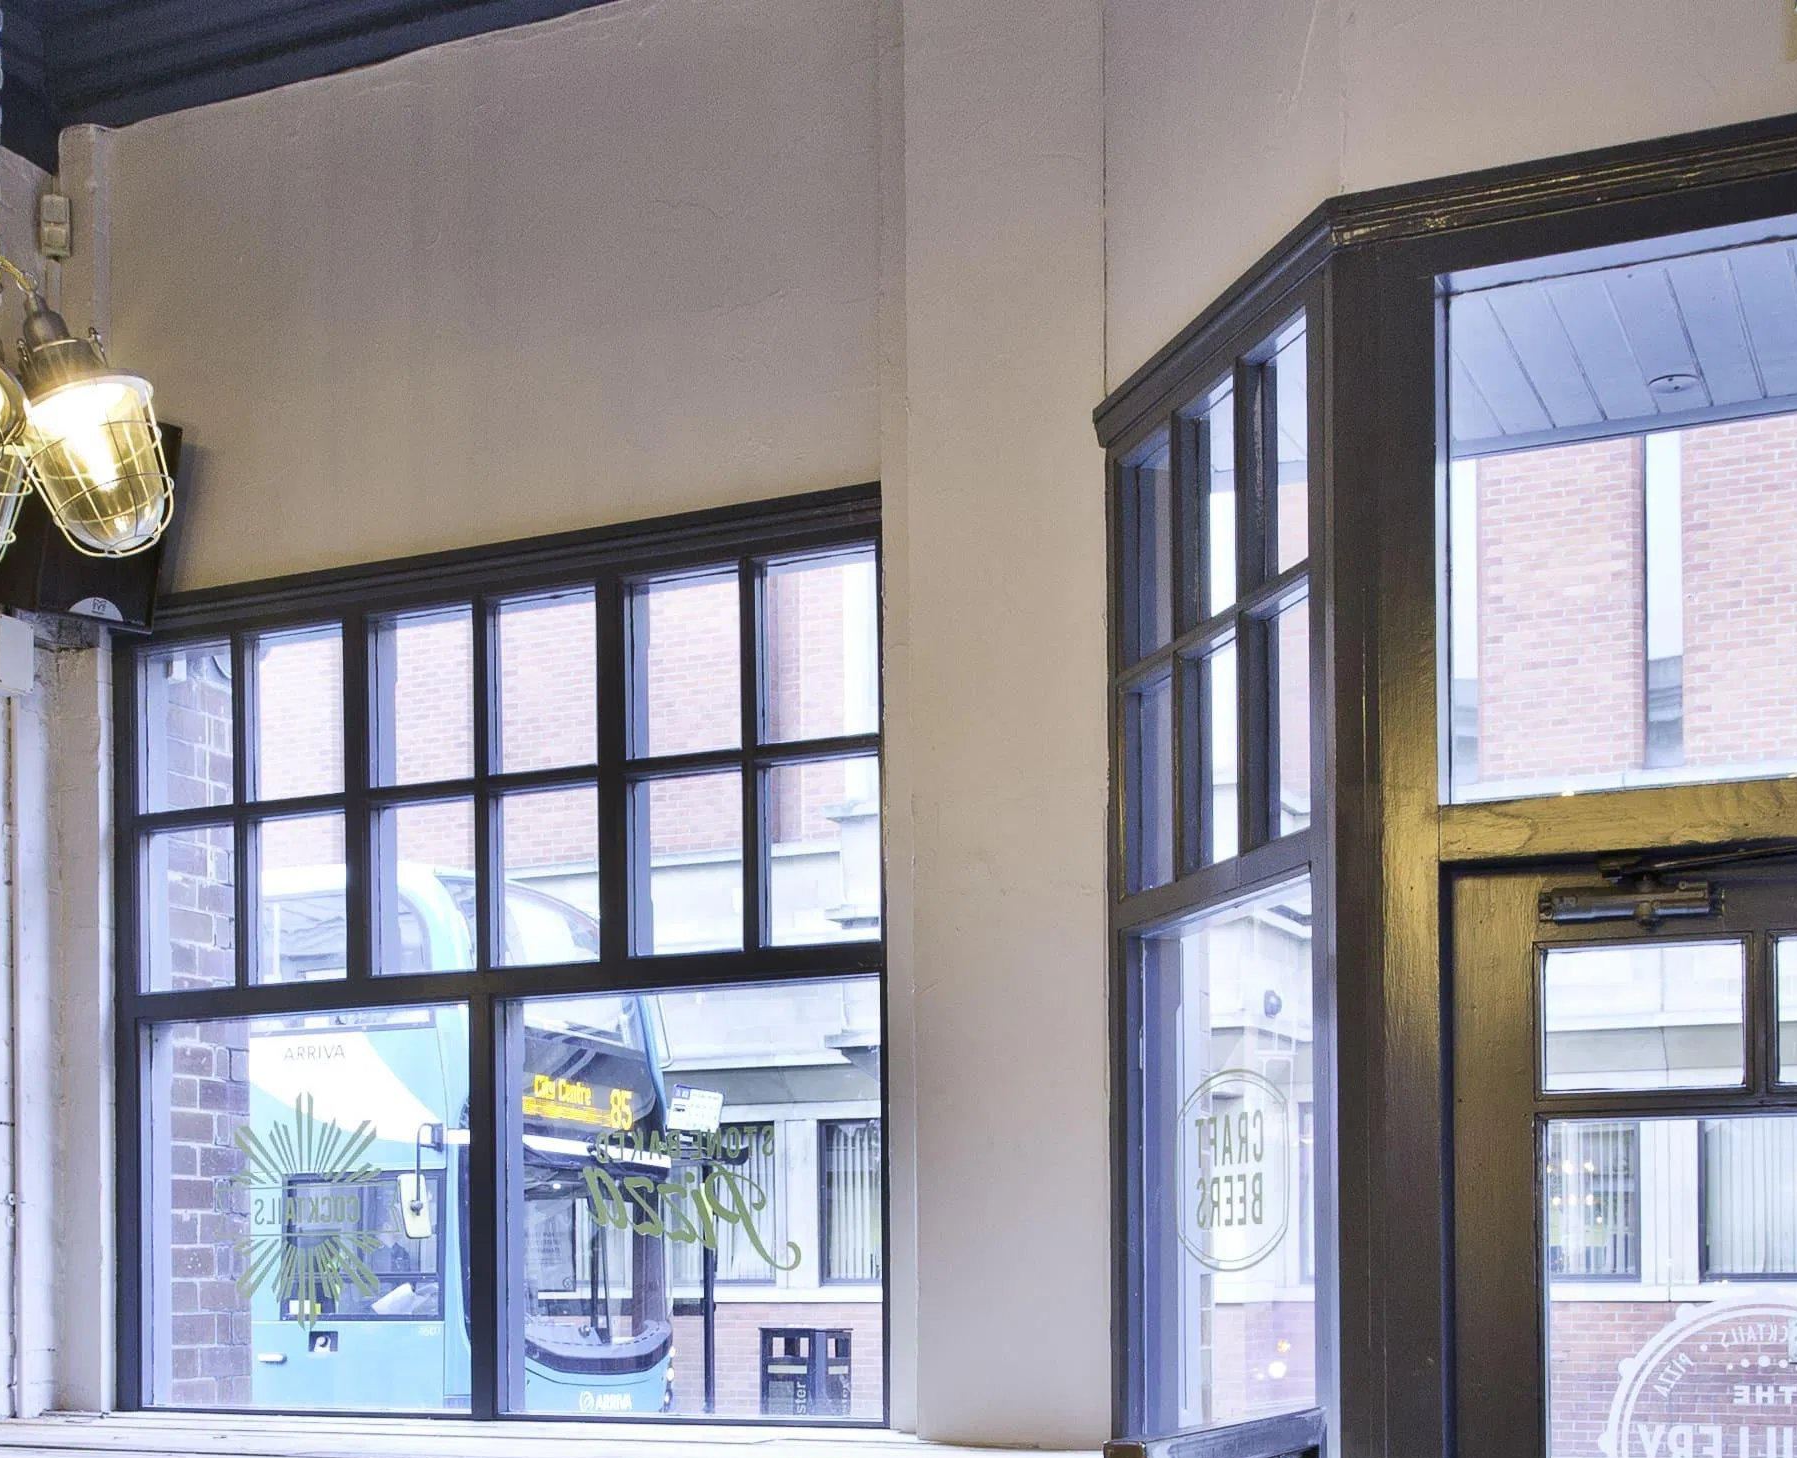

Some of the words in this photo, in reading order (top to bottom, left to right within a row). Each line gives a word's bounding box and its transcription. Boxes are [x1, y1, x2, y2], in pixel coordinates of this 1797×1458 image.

[283, 1044, 346, 1062] ARRIVA
[533, 1074, 556, 1101] City
[558, 1077, 593, 1106] Centre
[609, 1088, 634, 1131] 85
[595, 1392, 634, 1411] ARRIVA
